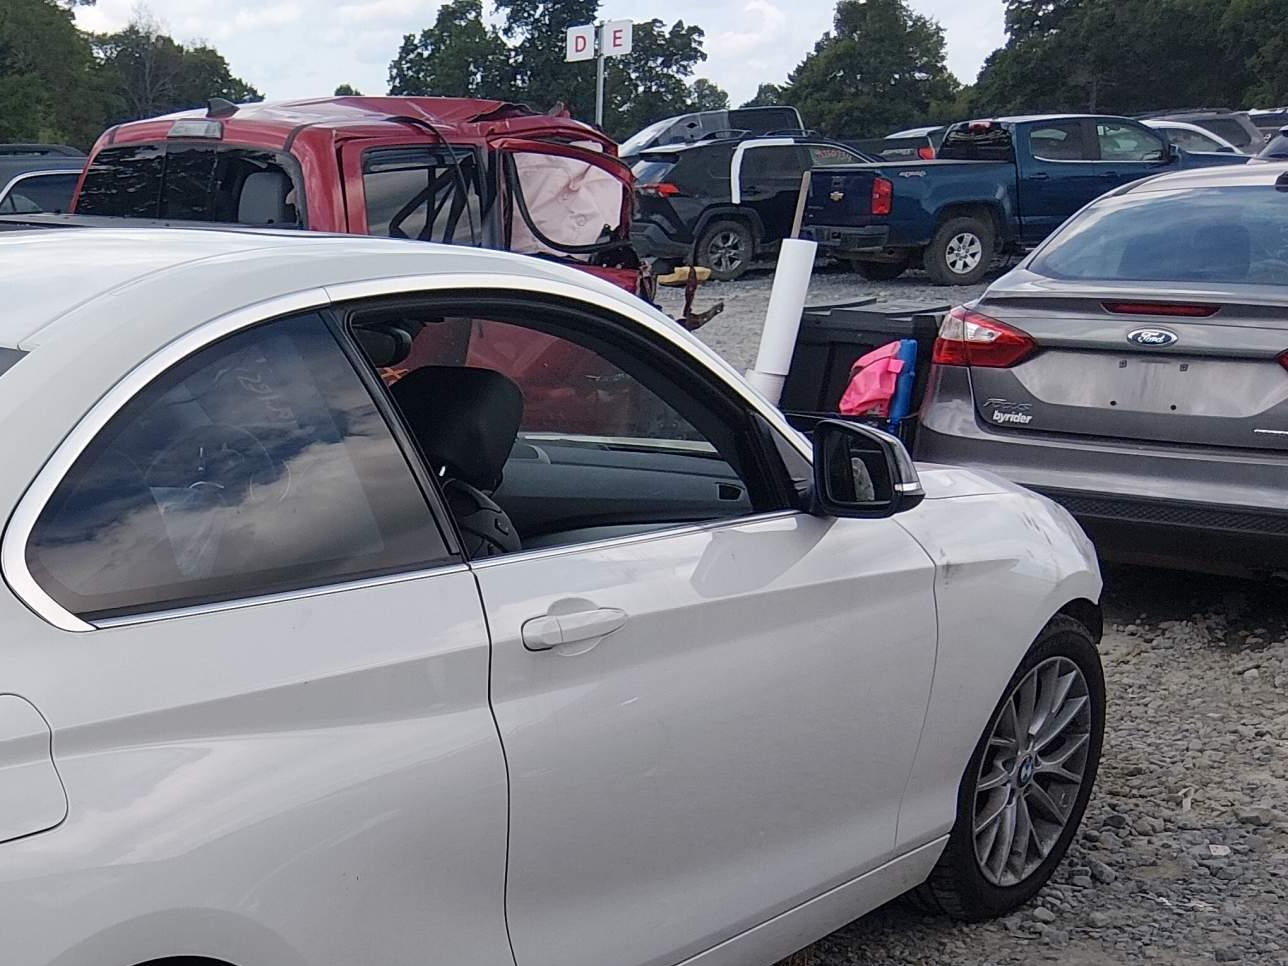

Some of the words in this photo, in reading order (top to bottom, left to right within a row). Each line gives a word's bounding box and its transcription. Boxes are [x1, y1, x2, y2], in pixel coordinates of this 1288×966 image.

[575, 35, 587, 53] D
[613, 29, 623, 47] E
[1137, 331, 1166, 343] Ford
[992, 410, 1033, 424] byrider
